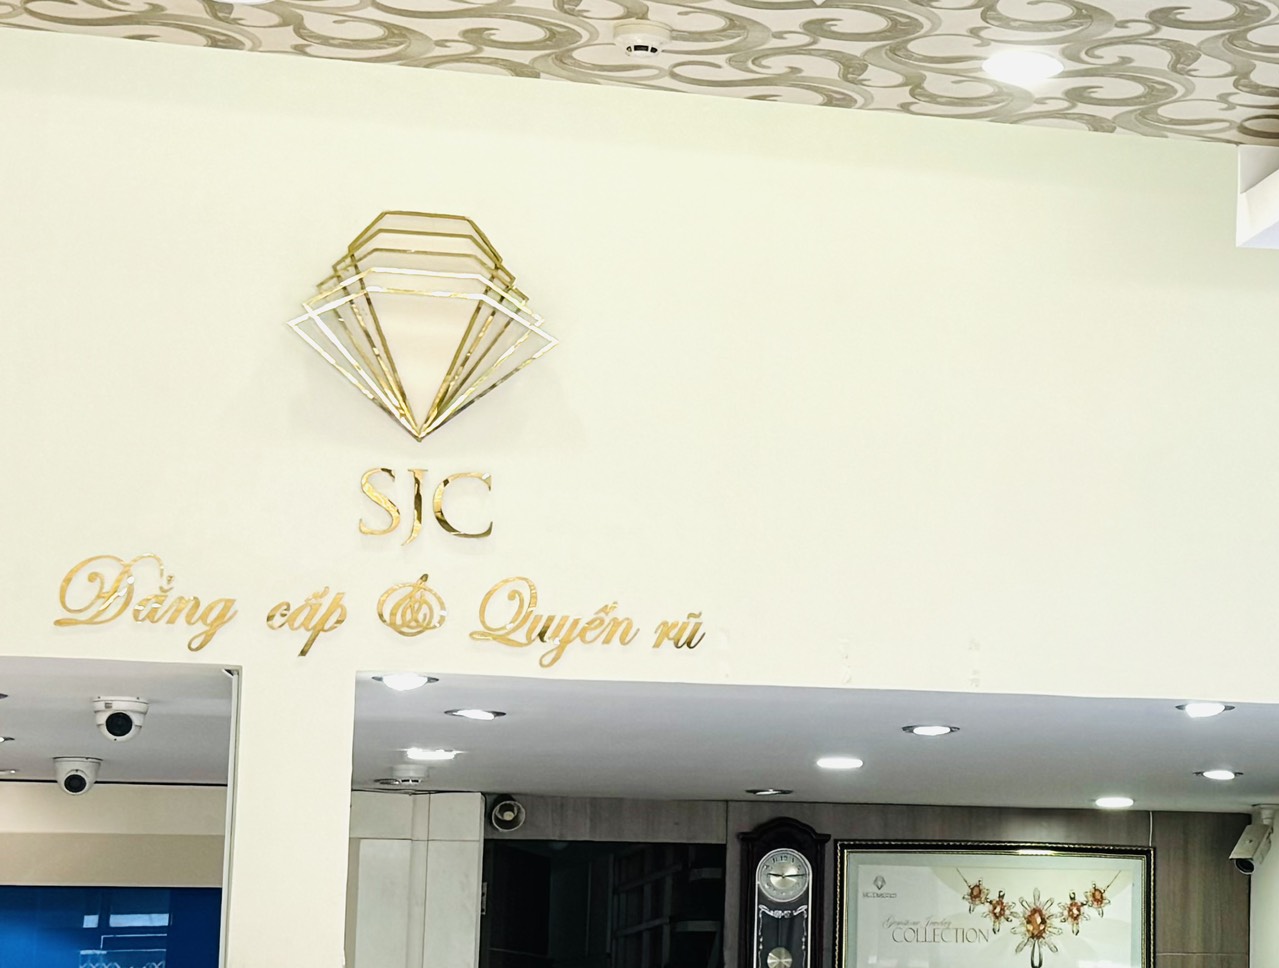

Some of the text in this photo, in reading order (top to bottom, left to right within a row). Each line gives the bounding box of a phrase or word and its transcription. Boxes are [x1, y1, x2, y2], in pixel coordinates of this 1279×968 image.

[359, 466, 494, 546] SJC
[266, 585, 347, 658] cấp
[469, 576, 639, 669] Quyến
[652, 608, 706, 651] rũ
[891, 926, 990, 944] COLLECTION
